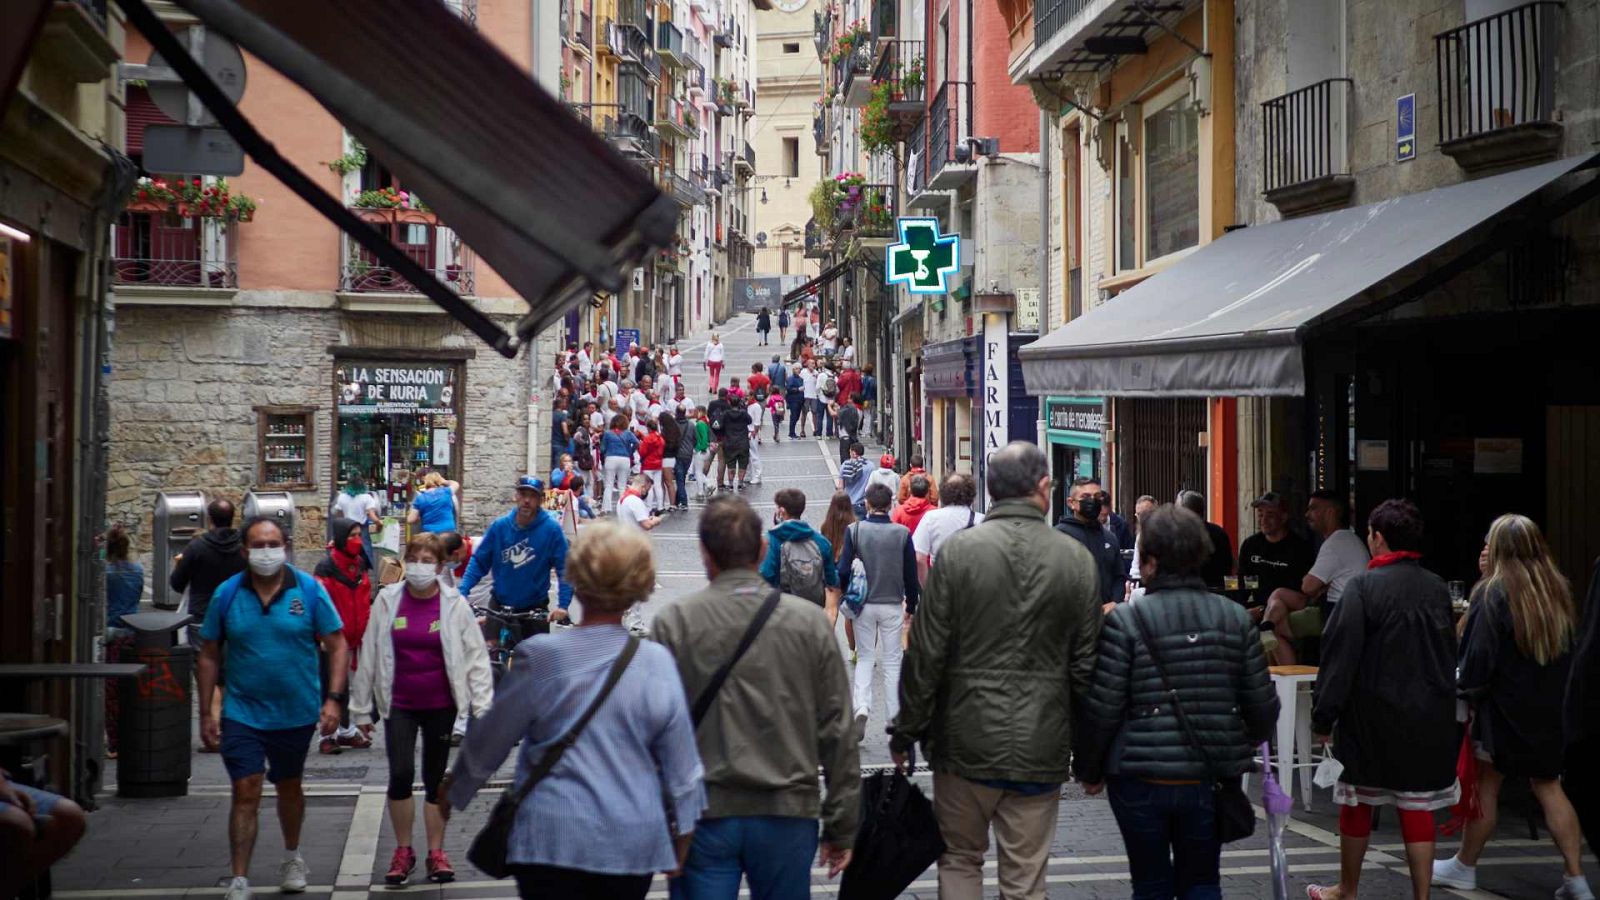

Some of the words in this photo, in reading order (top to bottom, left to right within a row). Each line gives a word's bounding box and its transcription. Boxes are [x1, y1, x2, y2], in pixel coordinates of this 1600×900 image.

[352, 367, 369, 382] LA
[374, 367, 444, 385] SENSACIÓN
[367, 384, 385, 400] DE
[389, 385, 428, 400] KURIA
